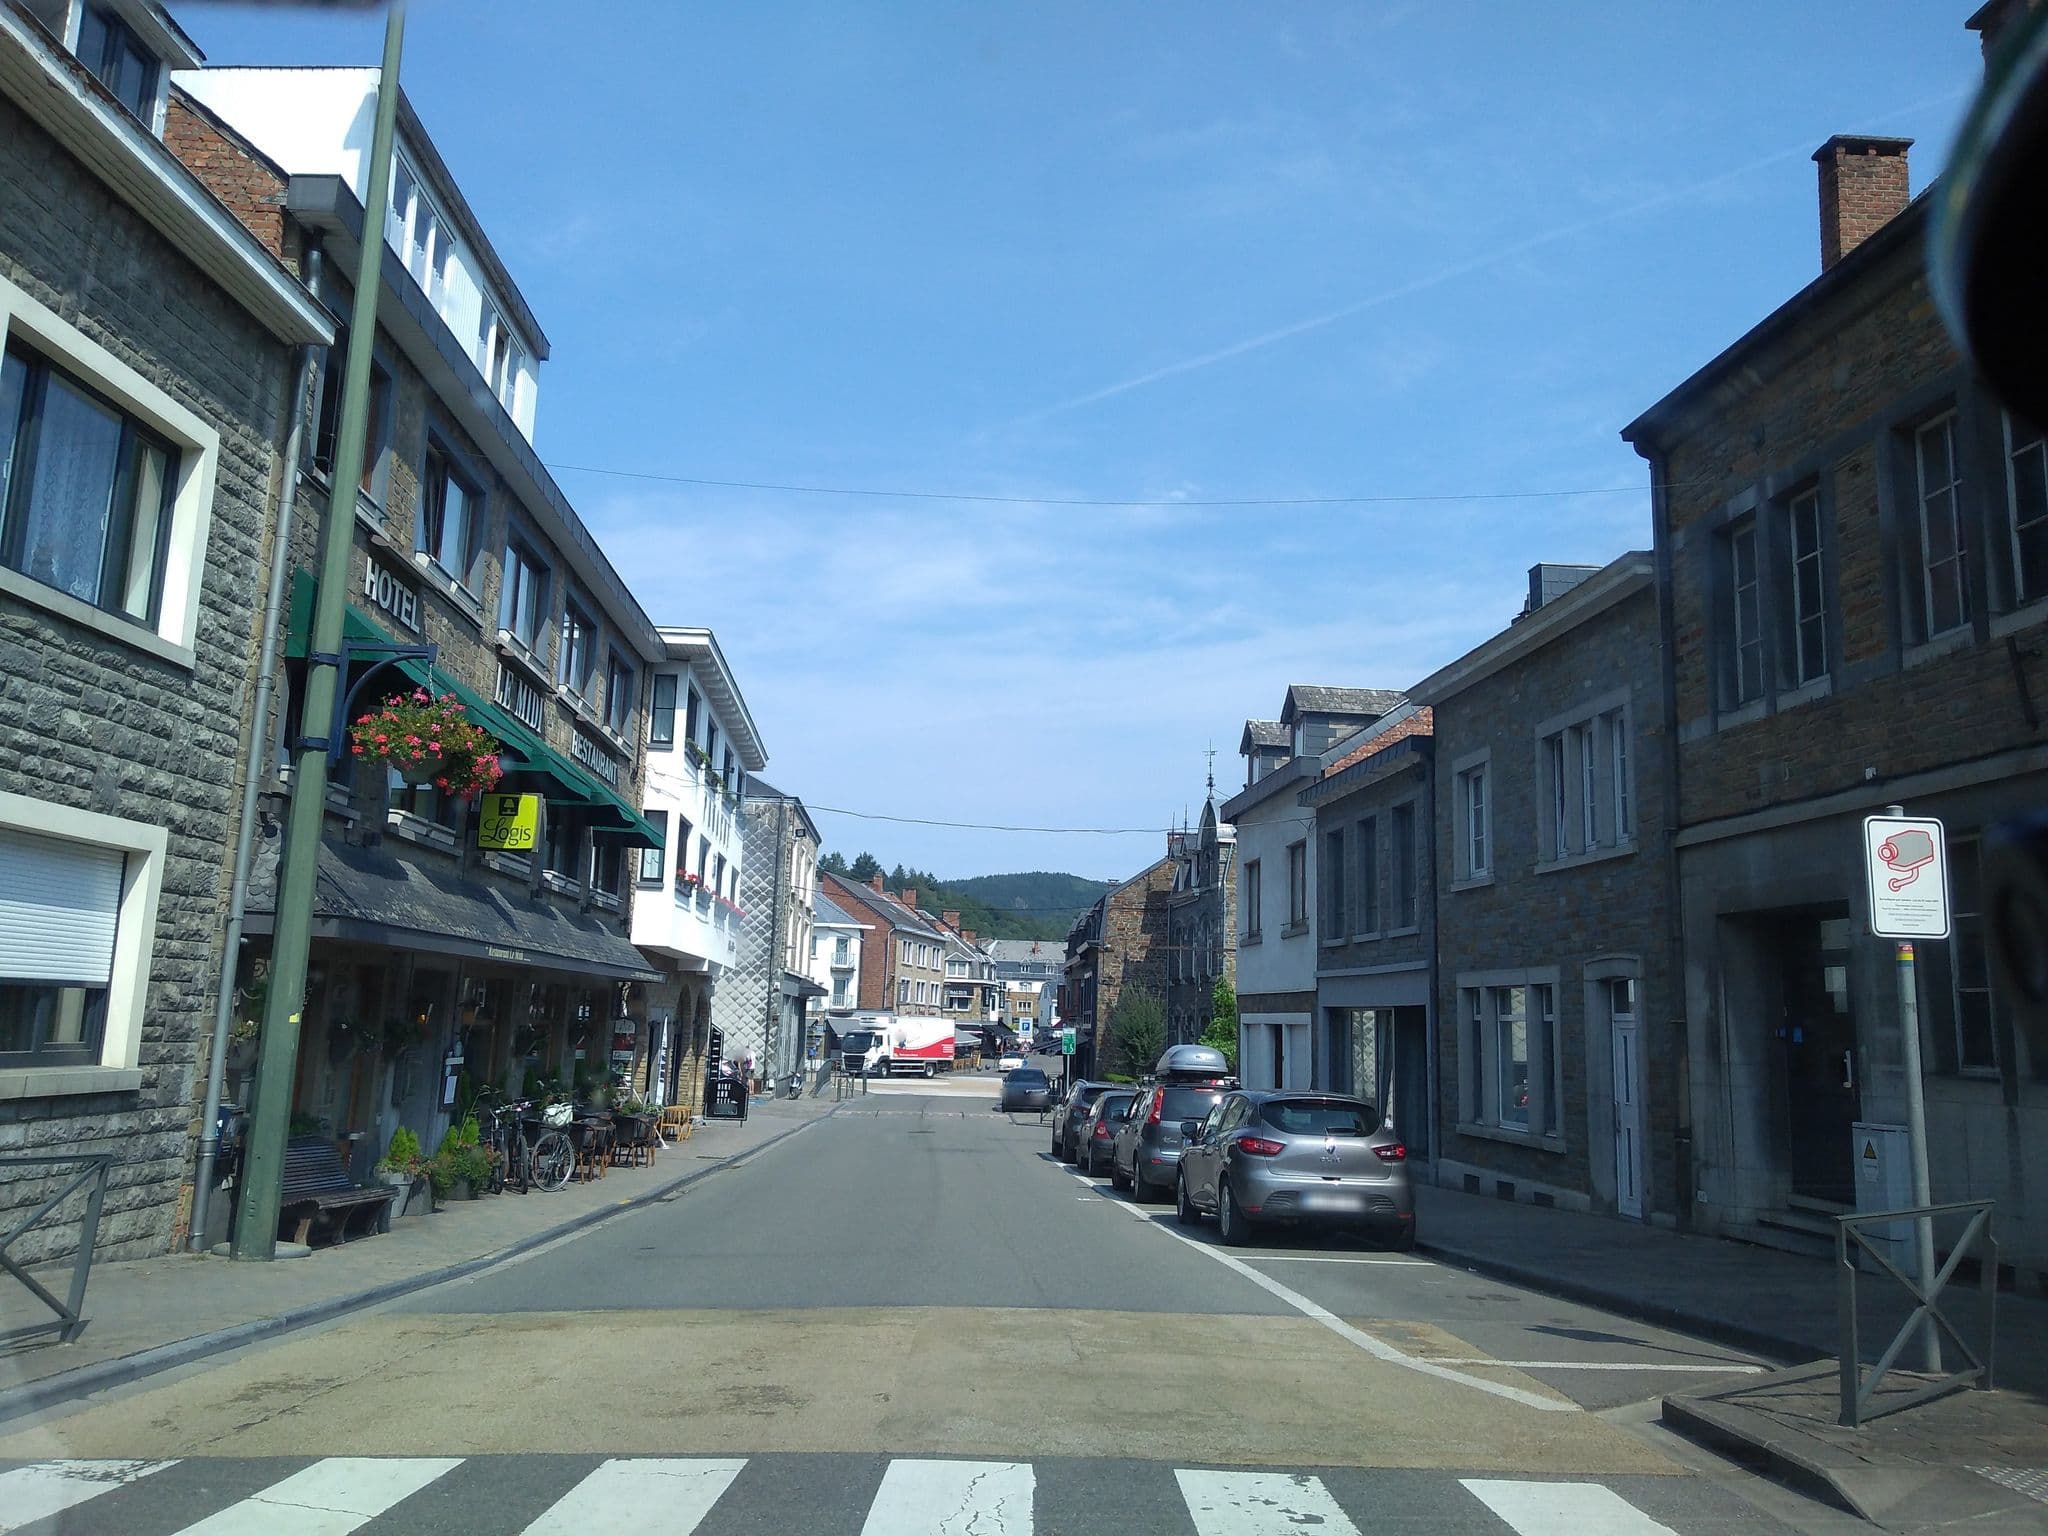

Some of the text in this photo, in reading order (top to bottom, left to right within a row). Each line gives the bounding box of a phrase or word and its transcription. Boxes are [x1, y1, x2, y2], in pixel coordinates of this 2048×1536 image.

[364, 556, 420, 634] HOTEL
[494, 661, 545, 733] LE MIDI
[571, 729, 618, 785] RESTAURANT
[480, 816, 532, 846] Logis
